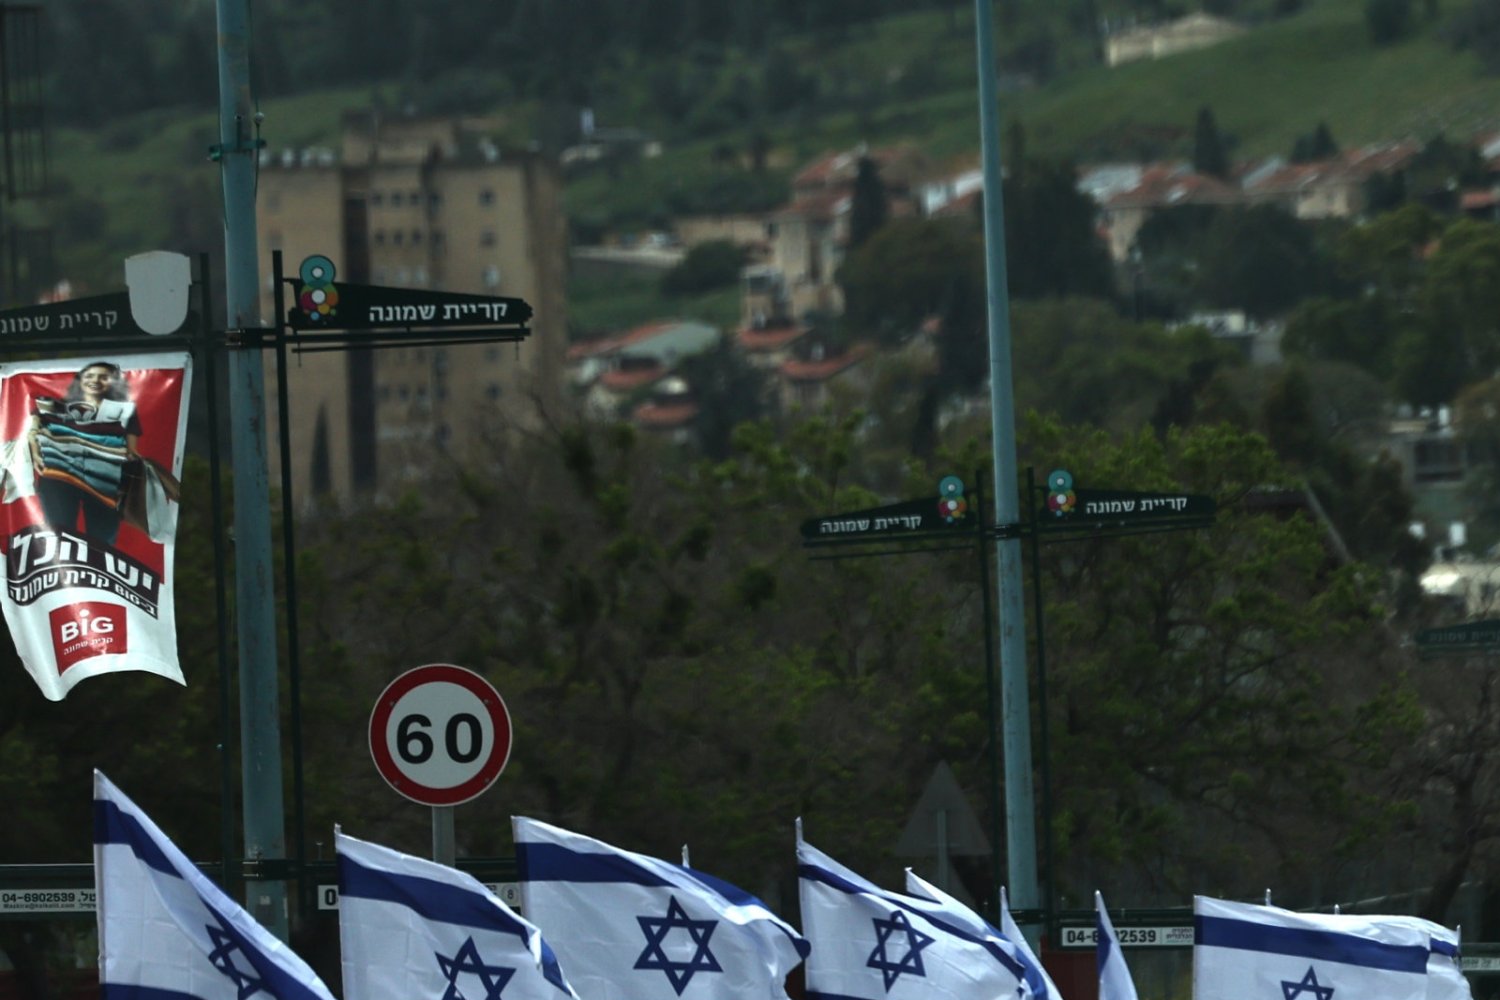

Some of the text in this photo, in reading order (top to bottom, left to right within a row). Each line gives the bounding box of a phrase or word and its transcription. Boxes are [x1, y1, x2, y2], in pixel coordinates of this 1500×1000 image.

[0, 310, 118, 334] קריית שמונ
[369, 303, 508, 323] קריית שמונה
[1085, 496, 1188, 515] קריית שמונה
[819, 514, 923, 533] קריית שמונה
[13, 531, 153, 591] יש הכל
[9, 571, 60, 603] שמונה
[64, 569, 110, 589] קרית
[396, 712, 484, 765] 60
[2, 892, 76, 903] 04-6902539
[1066, 930, 1157, 944] 04-62539
